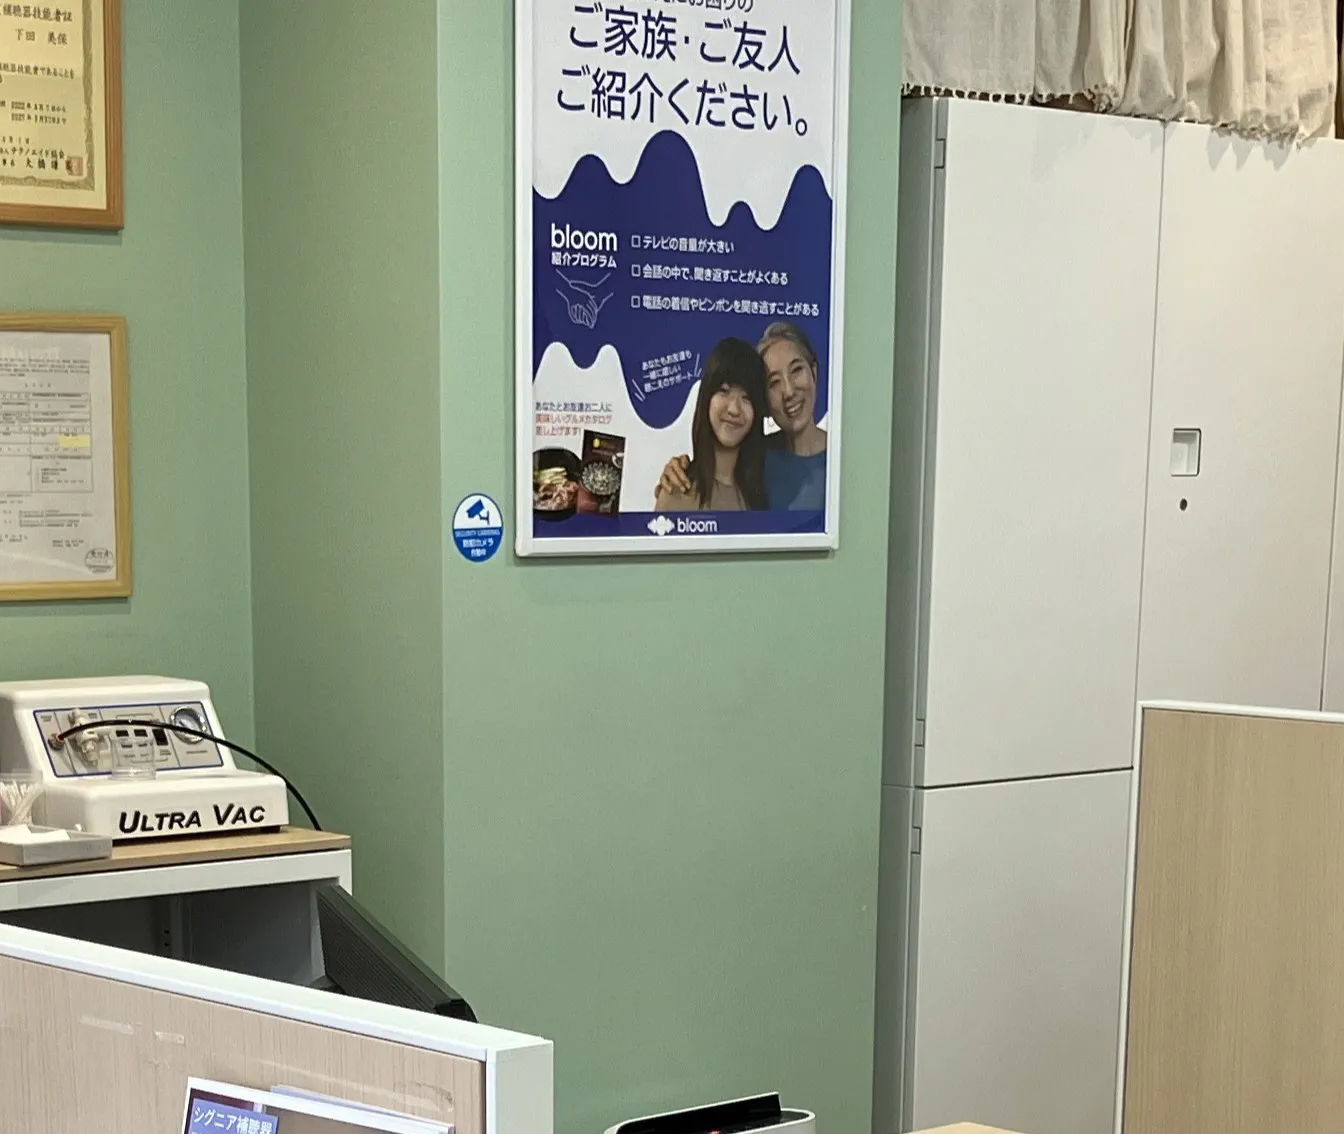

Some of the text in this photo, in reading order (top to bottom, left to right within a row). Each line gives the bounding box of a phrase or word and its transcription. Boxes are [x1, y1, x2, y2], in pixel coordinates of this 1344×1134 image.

[570, 2, 800, 75] ご家族・ご友人
[557, 65, 807, 136] ご紹介ください。
[551, 223, 618, 251] bloom
[643, 236, 735, 253] テレビの音量が大きい
[551, 252, 617, 268] 紹介プログラム
[677, 517, 718, 533] bloom
[119, 803, 266, 833] ULTRA VAC
